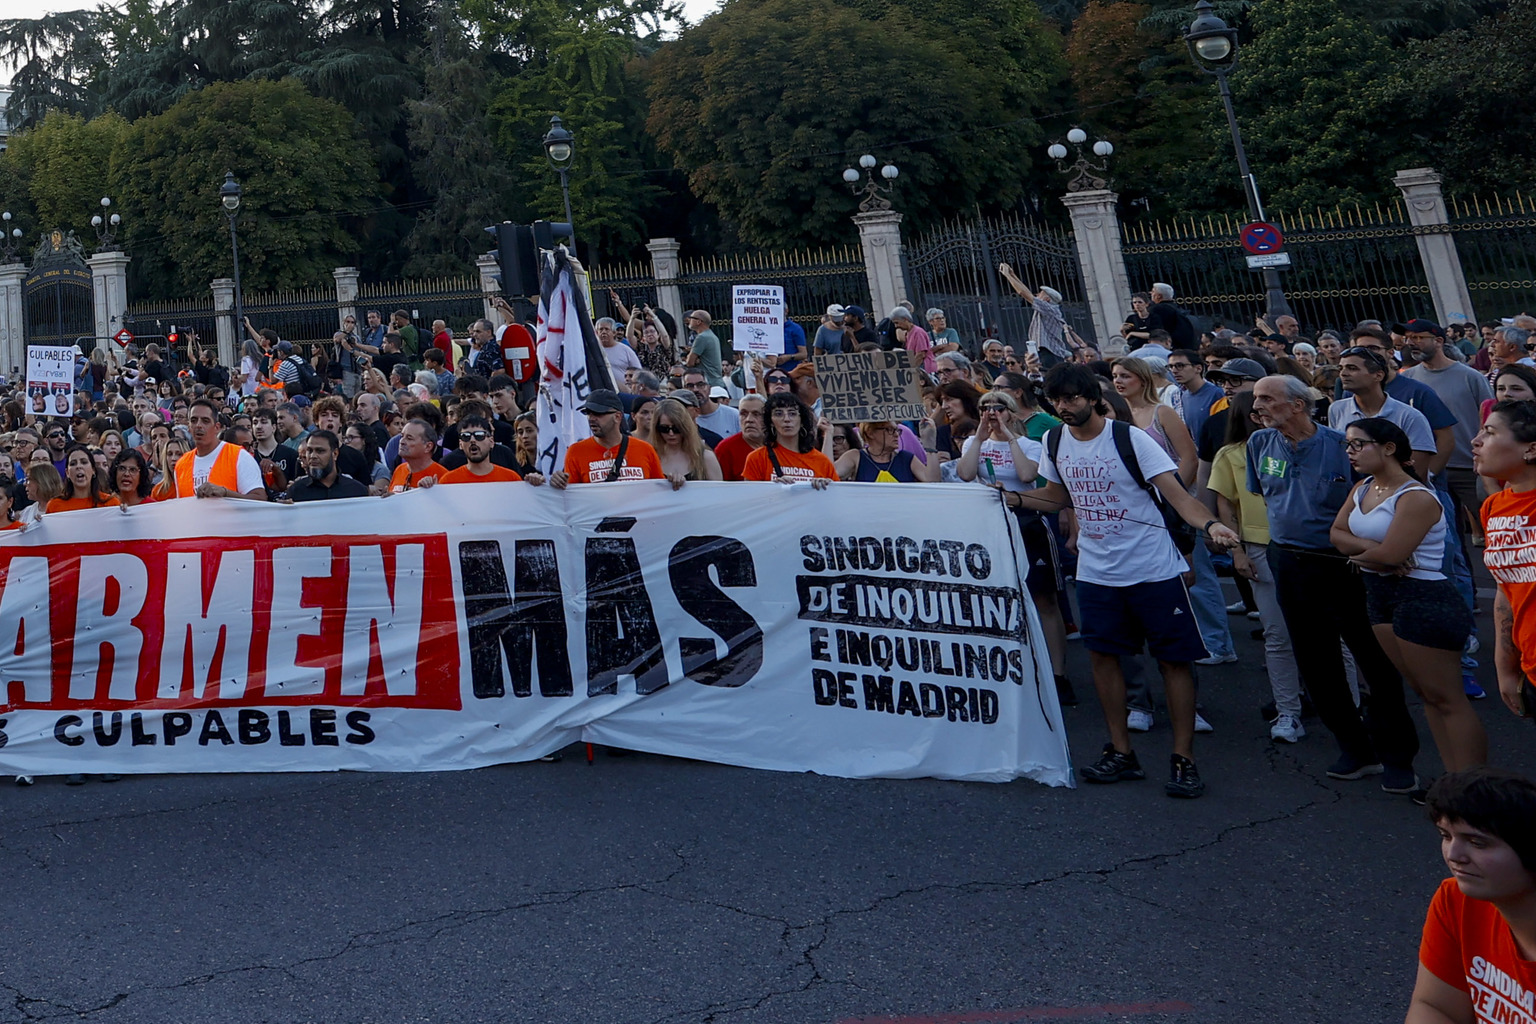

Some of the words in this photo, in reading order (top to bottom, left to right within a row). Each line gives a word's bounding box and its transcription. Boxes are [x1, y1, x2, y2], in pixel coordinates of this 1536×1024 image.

[738, 316, 767, 324] GENERAL
[769, 317, 778, 325] YA
[30, 350, 72, 361] CULPABLES
[815, 356, 834, 372] EL
[835, 353, 874, 372] PLAN
[884, 351, 911, 368] DE
[817, 370, 893, 392] VIVIENDA
[896, 369, 913, 386] NO
[823, 392, 869, 408] DEBE
[871, 387, 908, 404] SER
[871, 404, 928, 420] ESPECULAR
[591, 472, 600, 481] DE
[1067, 481, 1115, 492] LAVELES
[800, 535, 992, 580] SINDICATO
[458, 516, 764, 698] MÁS
[808, 583, 848, 614] DE
[809, 626, 831, 662] E
[836, 629, 1023, 685] INQUILINOS
[812, 668, 857, 709] DE
[862, 675, 999, 724] MADRID
[53, 709, 376, 746] CULPABLES
[1470, 956, 1536, 1017] SINDICA
